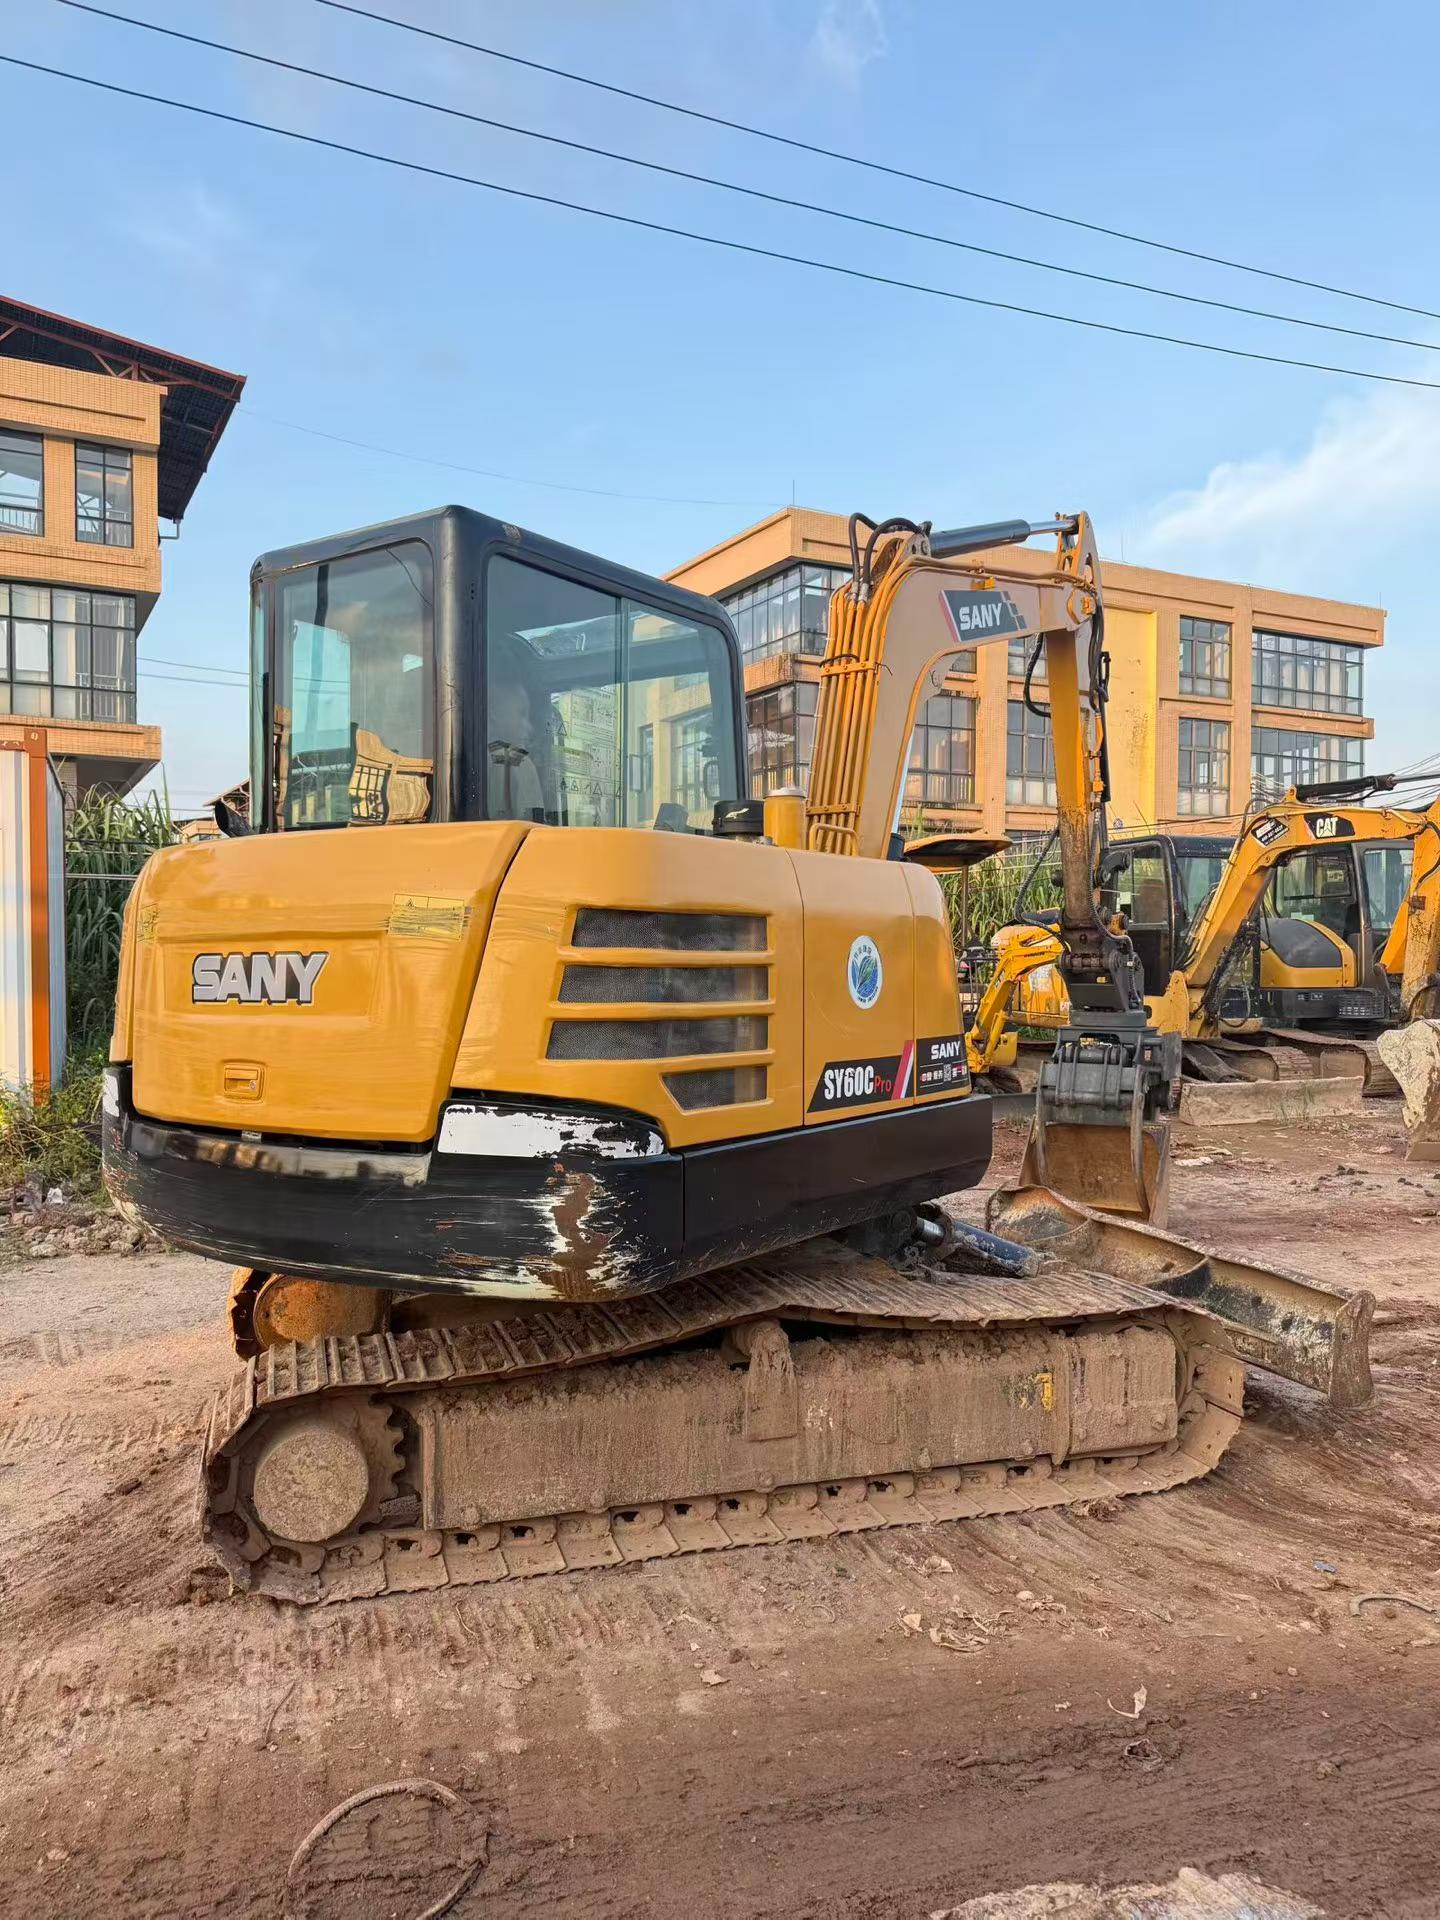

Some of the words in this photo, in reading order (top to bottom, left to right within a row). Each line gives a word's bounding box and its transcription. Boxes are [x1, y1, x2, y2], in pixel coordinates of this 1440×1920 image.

[959, 603, 1002, 631] SANY
[1316, 816, 1338, 838] CAT
[193, 953, 328, 1003] SANY
[930, 1041, 961, 1060] SANY
[824, 1065, 875, 1100] SY60C
